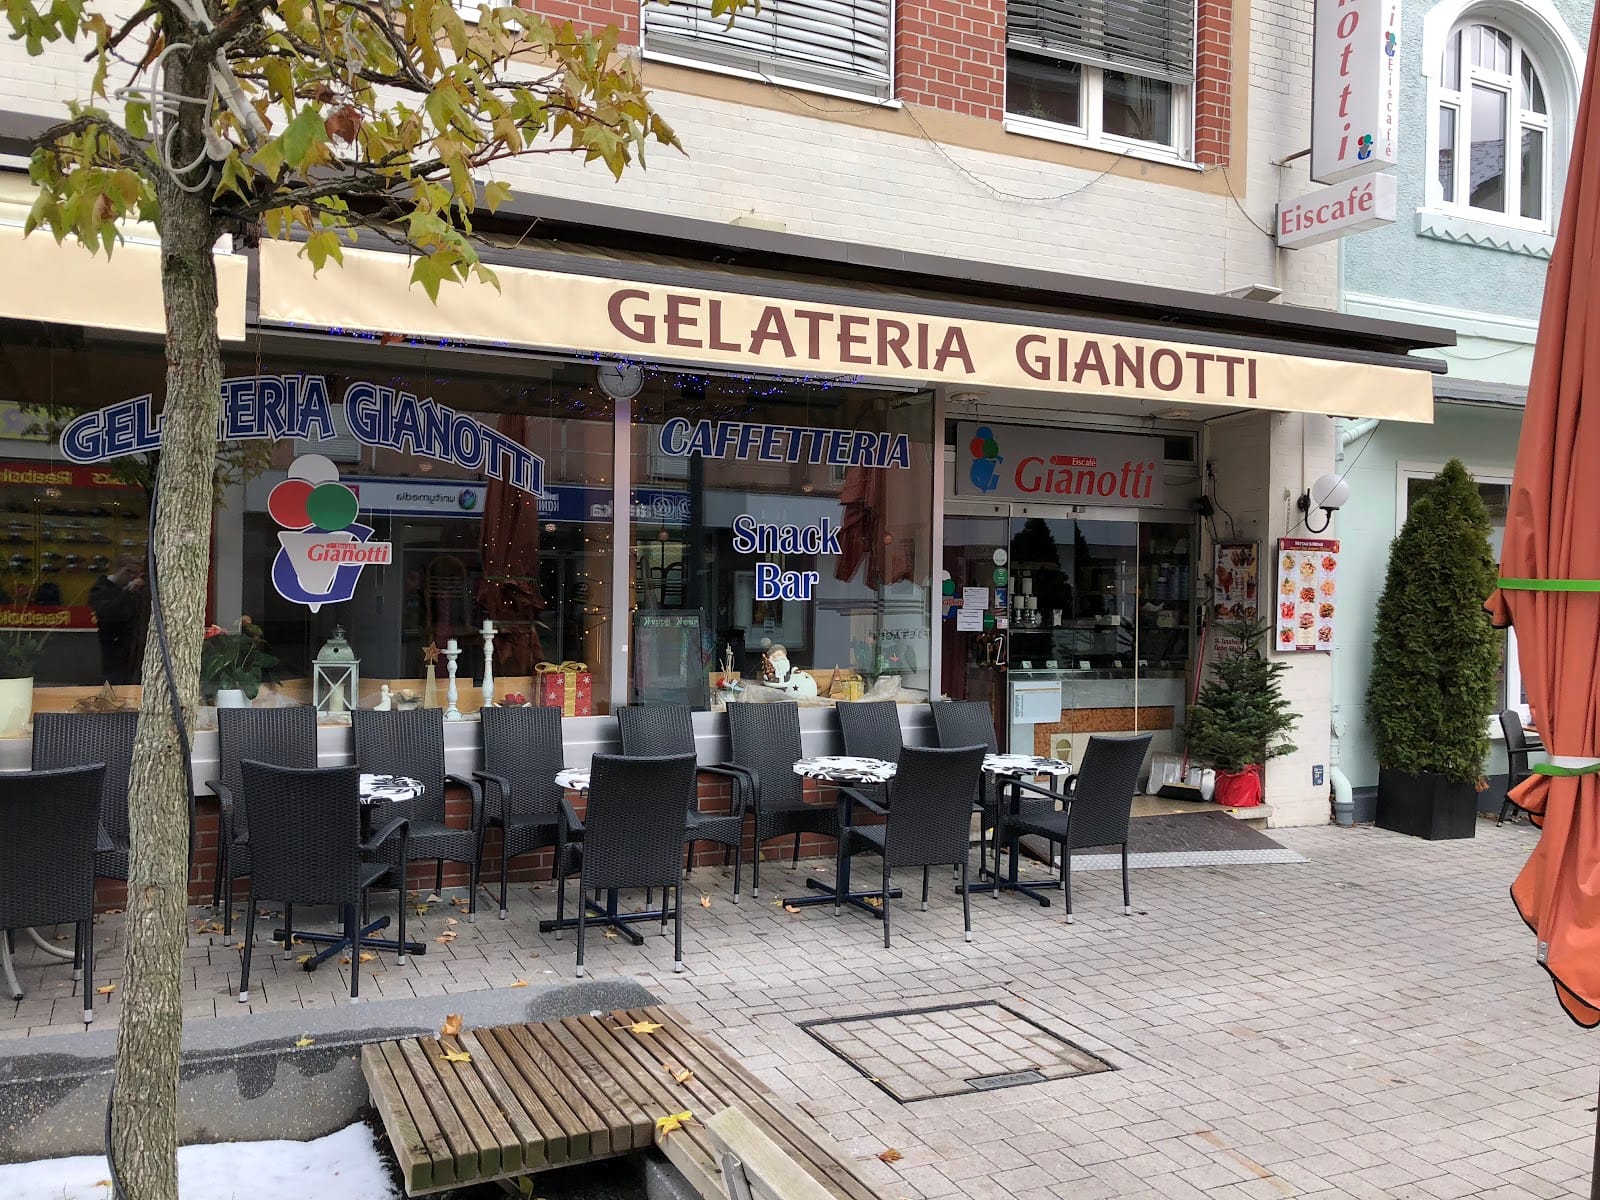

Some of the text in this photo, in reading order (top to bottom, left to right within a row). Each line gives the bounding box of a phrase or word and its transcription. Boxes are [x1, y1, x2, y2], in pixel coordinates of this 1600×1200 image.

[1336, 0, 1359, 161] otti
[1385, 59, 1394, 157] Eiscafé
[1281, 182, 1373, 236] Eiscafé
[607, 288, 1257, 399] GELATERIA GIANOTTI
[60, 375, 545, 498] GELERIA GIANOTTI
[660, 417, 911, 469] CAFFETTERIA
[1014, 455, 1155, 499] Gianotti
[307, 543, 388, 563] Gianotti
[732, 514, 843, 555] Snack
[755, 563, 820, 601] Bar
